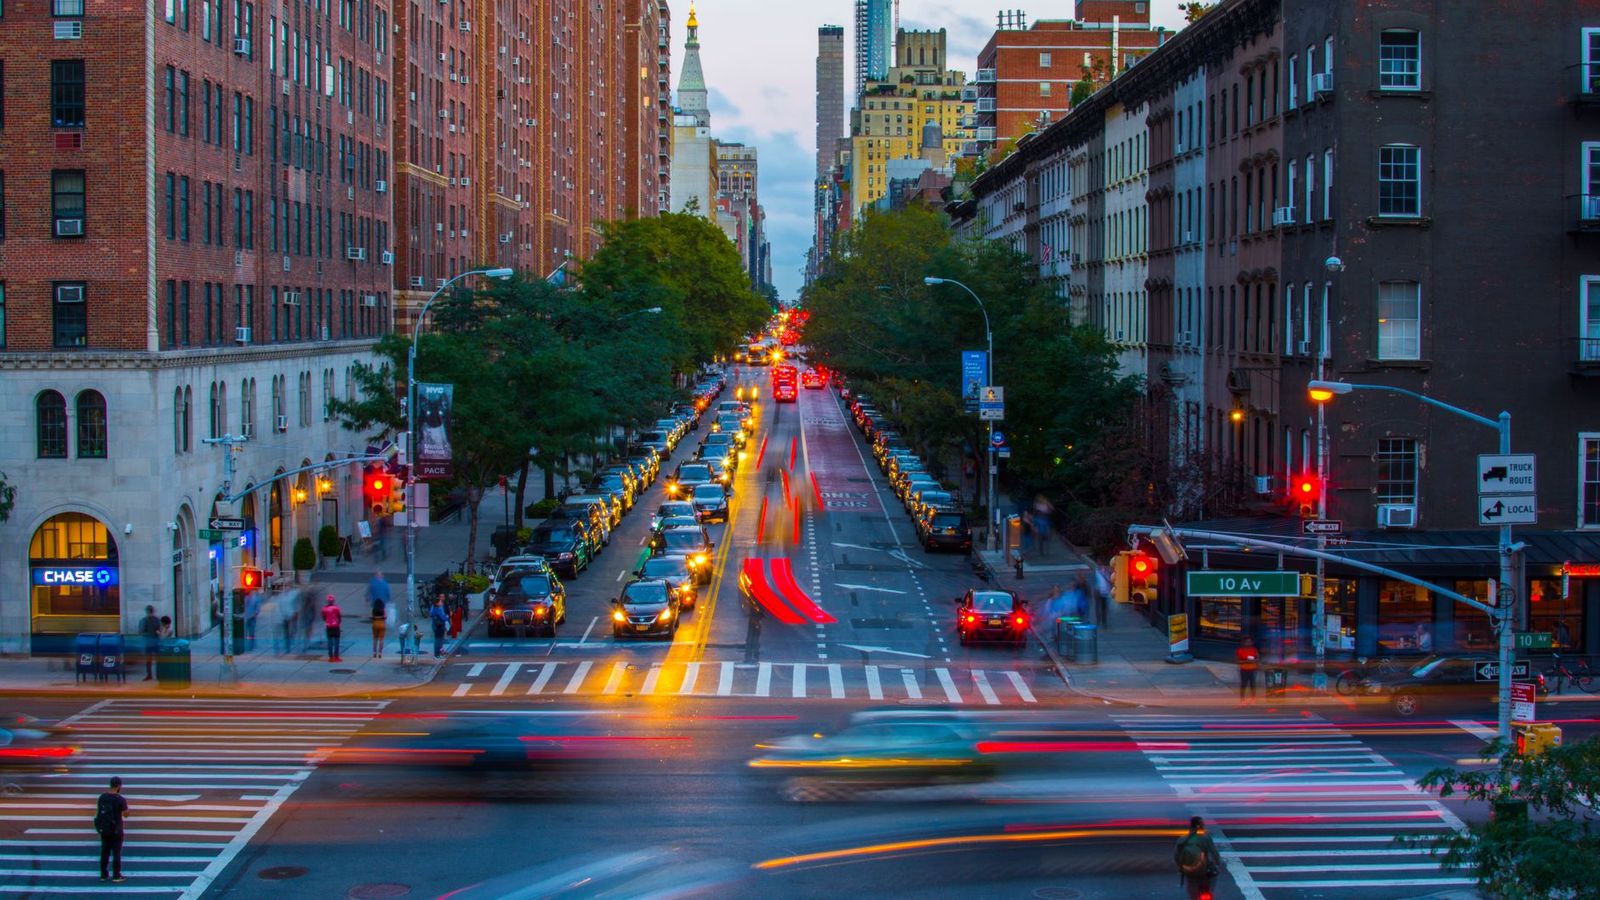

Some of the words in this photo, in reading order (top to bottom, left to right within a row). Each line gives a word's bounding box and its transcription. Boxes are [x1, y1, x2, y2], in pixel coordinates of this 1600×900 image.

[1509, 463, 1533, 472] TRUCK
[1509, 476, 1533, 485] ROUTE
[1507, 505, 1535, 514] LOCAL
[202, 529, 211, 538] 10
[44, 570, 94, 583] CHASE
[1220, 578, 1236, 591] 10
[1240, 578, 1262, 591] Av
[1519, 635, 1532, 647] 10
[1484, 666, 1499, 676] ONE
